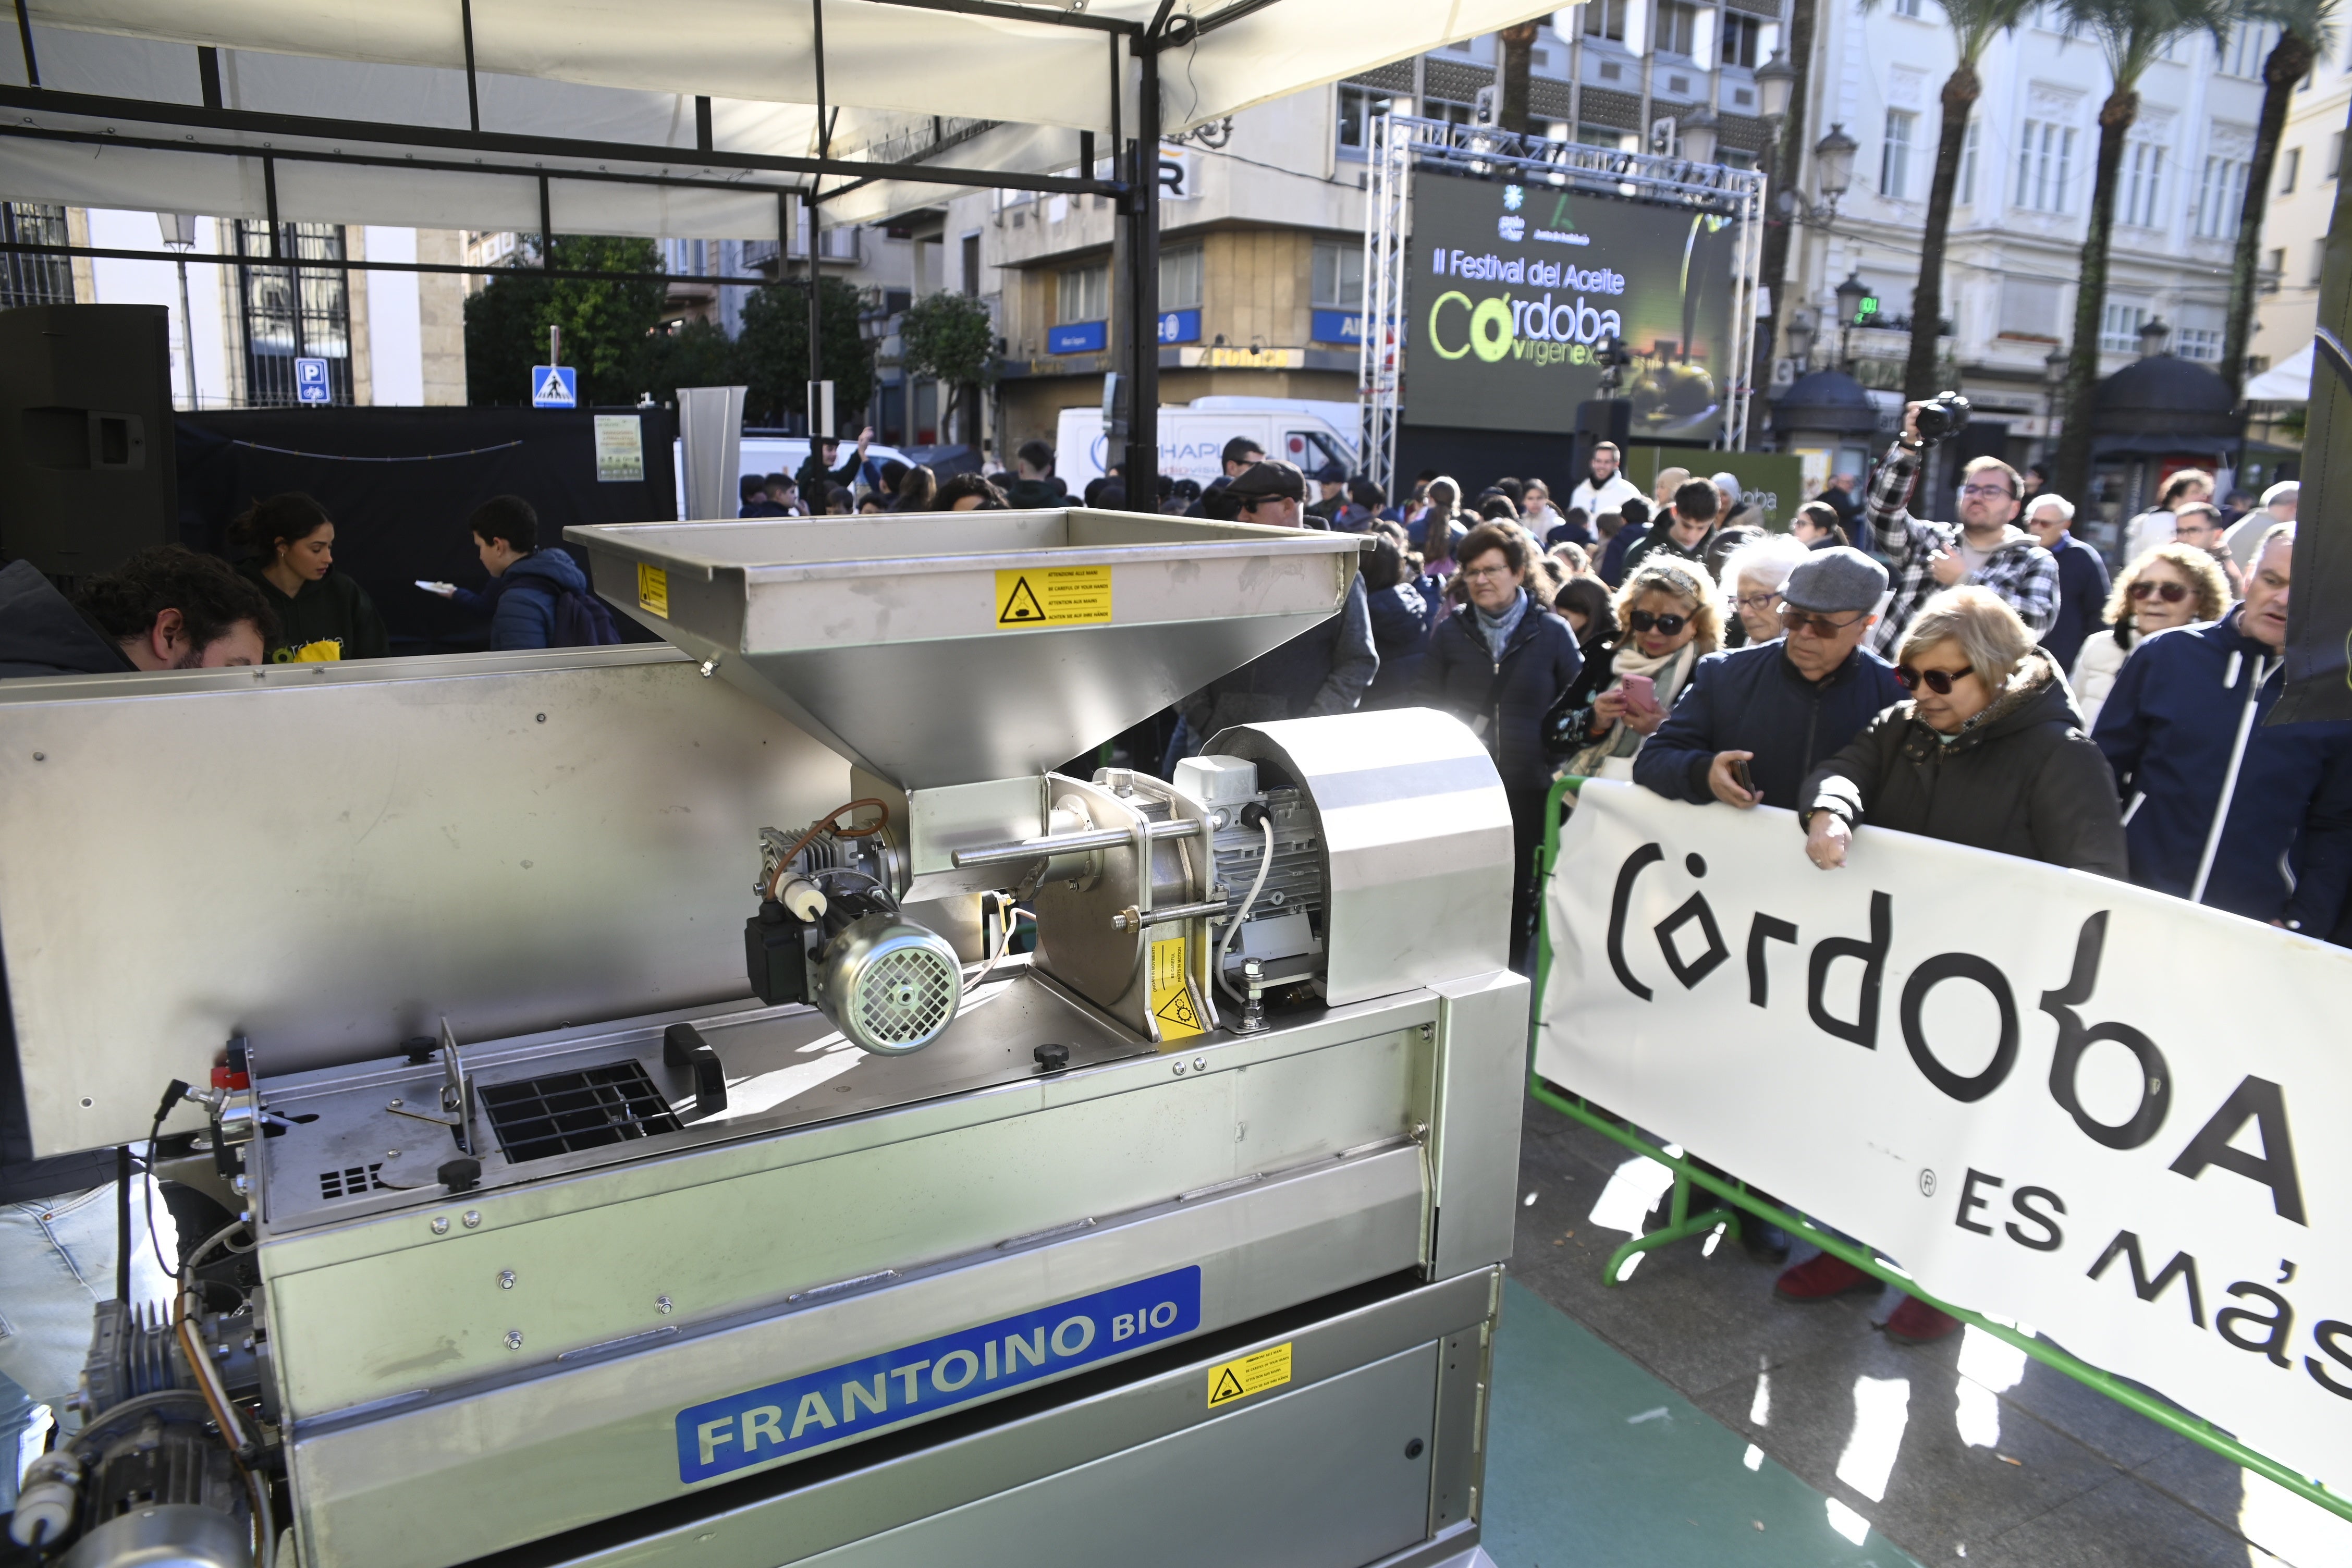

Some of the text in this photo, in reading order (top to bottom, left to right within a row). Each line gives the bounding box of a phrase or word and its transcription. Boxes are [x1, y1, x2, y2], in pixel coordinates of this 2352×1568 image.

[1433, 248, 1625, 295] II Festival del Aceite
[1429, 290, 1621, 362] Córdoba
[304, 365, 319, 381] P
[1955, 1167, 2068, 1252] ES
[697, 1301, 1179, 1466] FRANTOINO BIO
